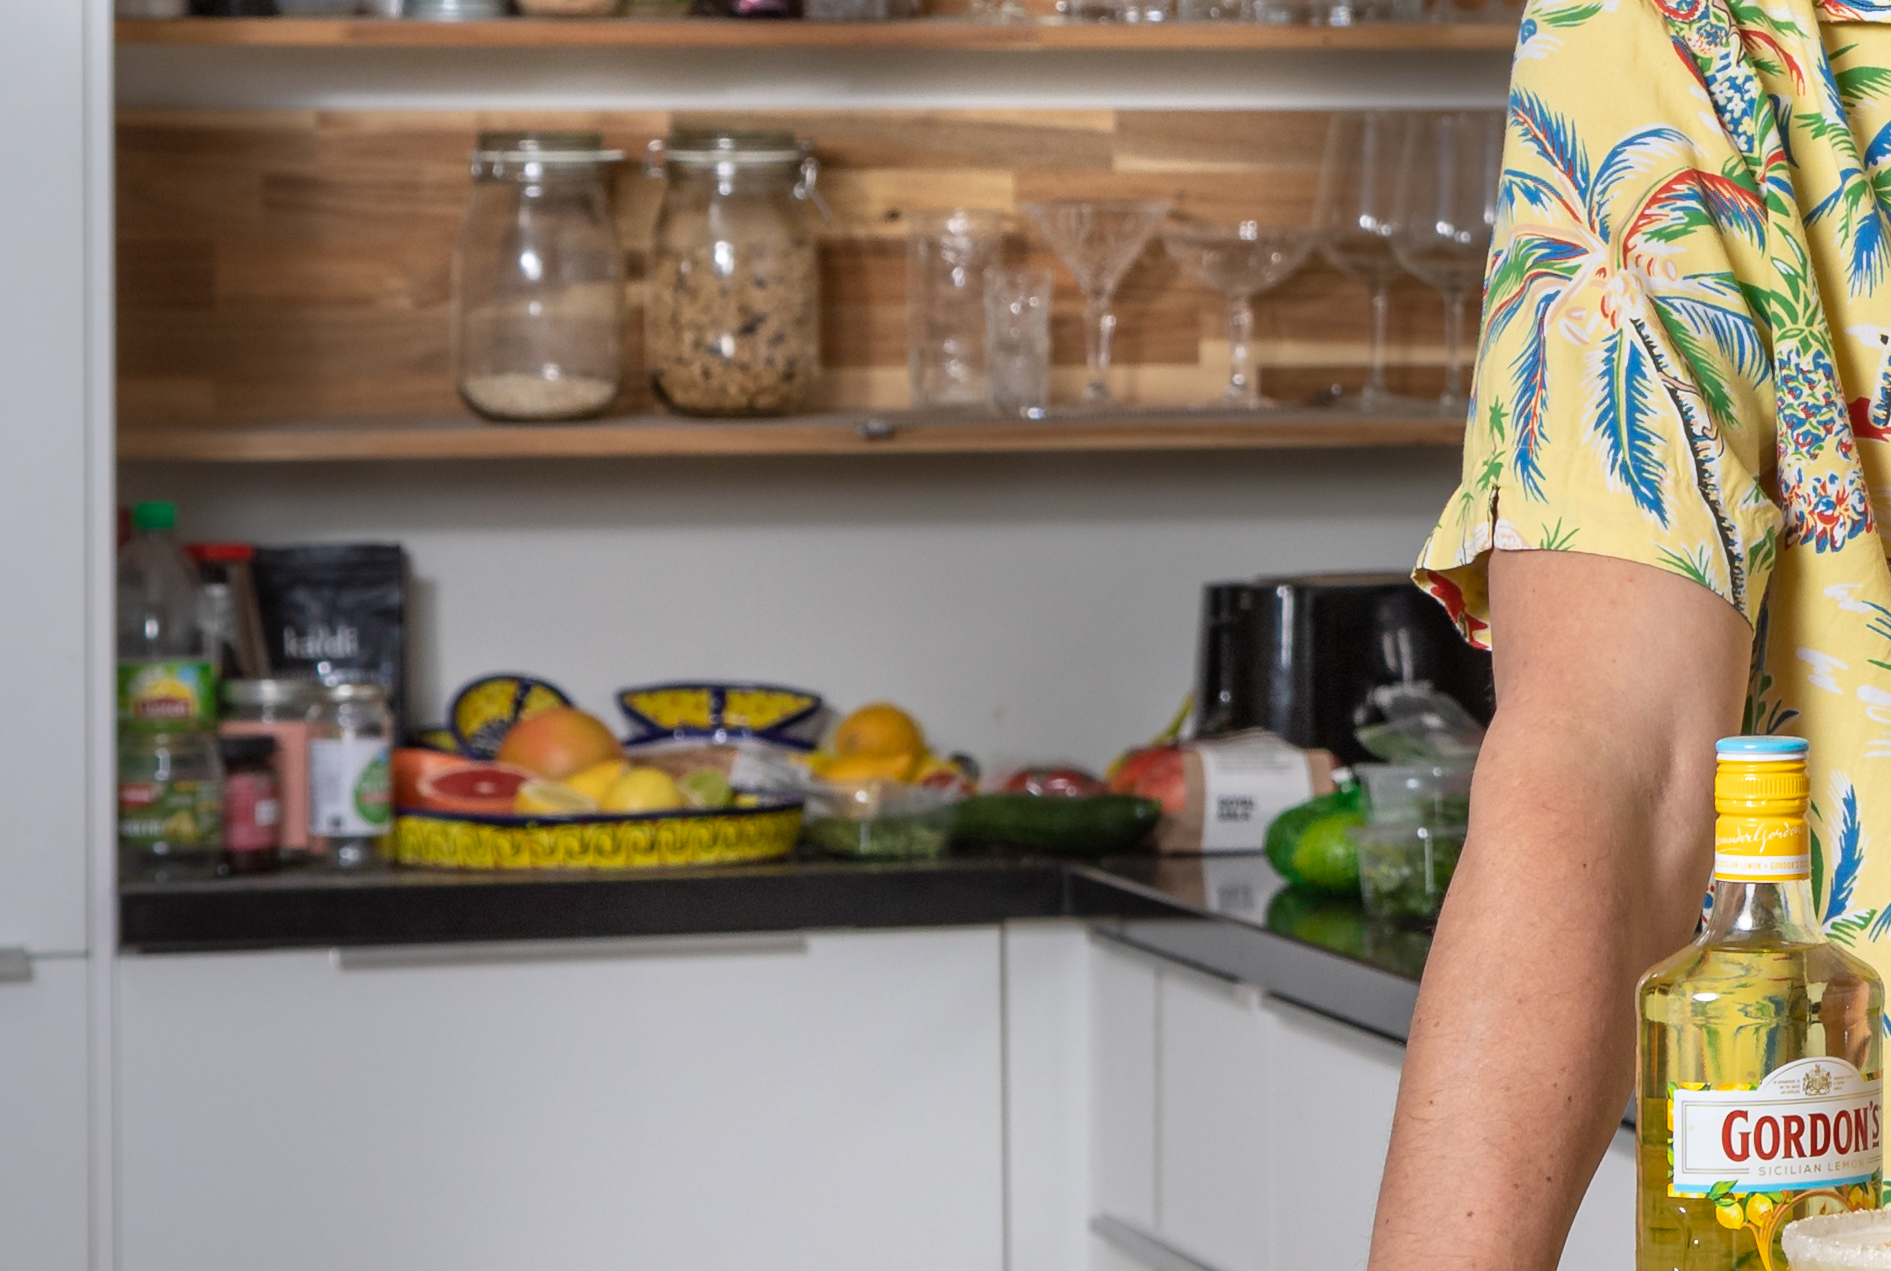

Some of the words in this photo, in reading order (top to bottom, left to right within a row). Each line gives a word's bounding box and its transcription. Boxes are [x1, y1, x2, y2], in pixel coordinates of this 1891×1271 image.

[1721, 1099, 1880, 1163] GORDON'S
[1758, 1164, 1823, 1177] SICILIAN
[1827, 1158, 1866, 1172] LEMON
